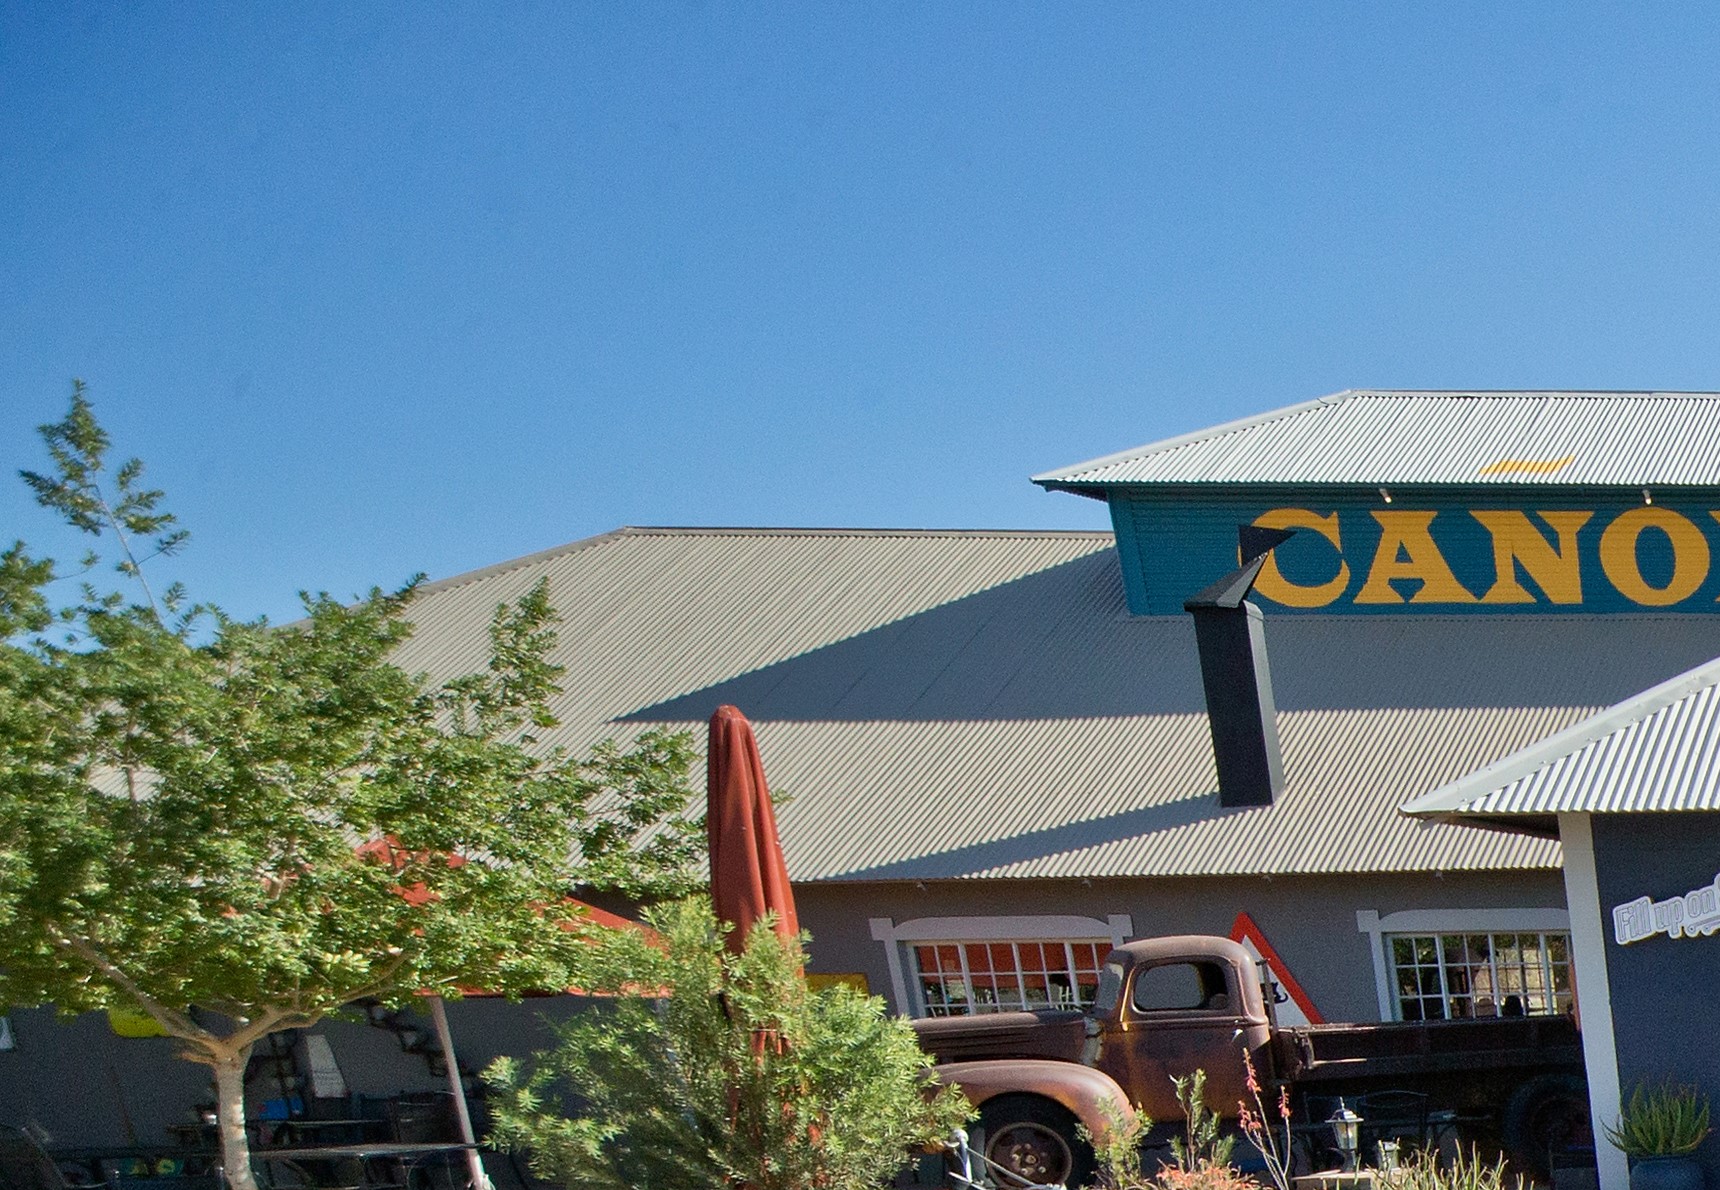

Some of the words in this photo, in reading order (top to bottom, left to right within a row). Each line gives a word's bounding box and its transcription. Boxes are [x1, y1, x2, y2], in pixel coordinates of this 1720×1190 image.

[1614, 898, 1653, 943] Fill
[1653, 898, 1685, 935] up
[1686, 888, 1717, 918] on
